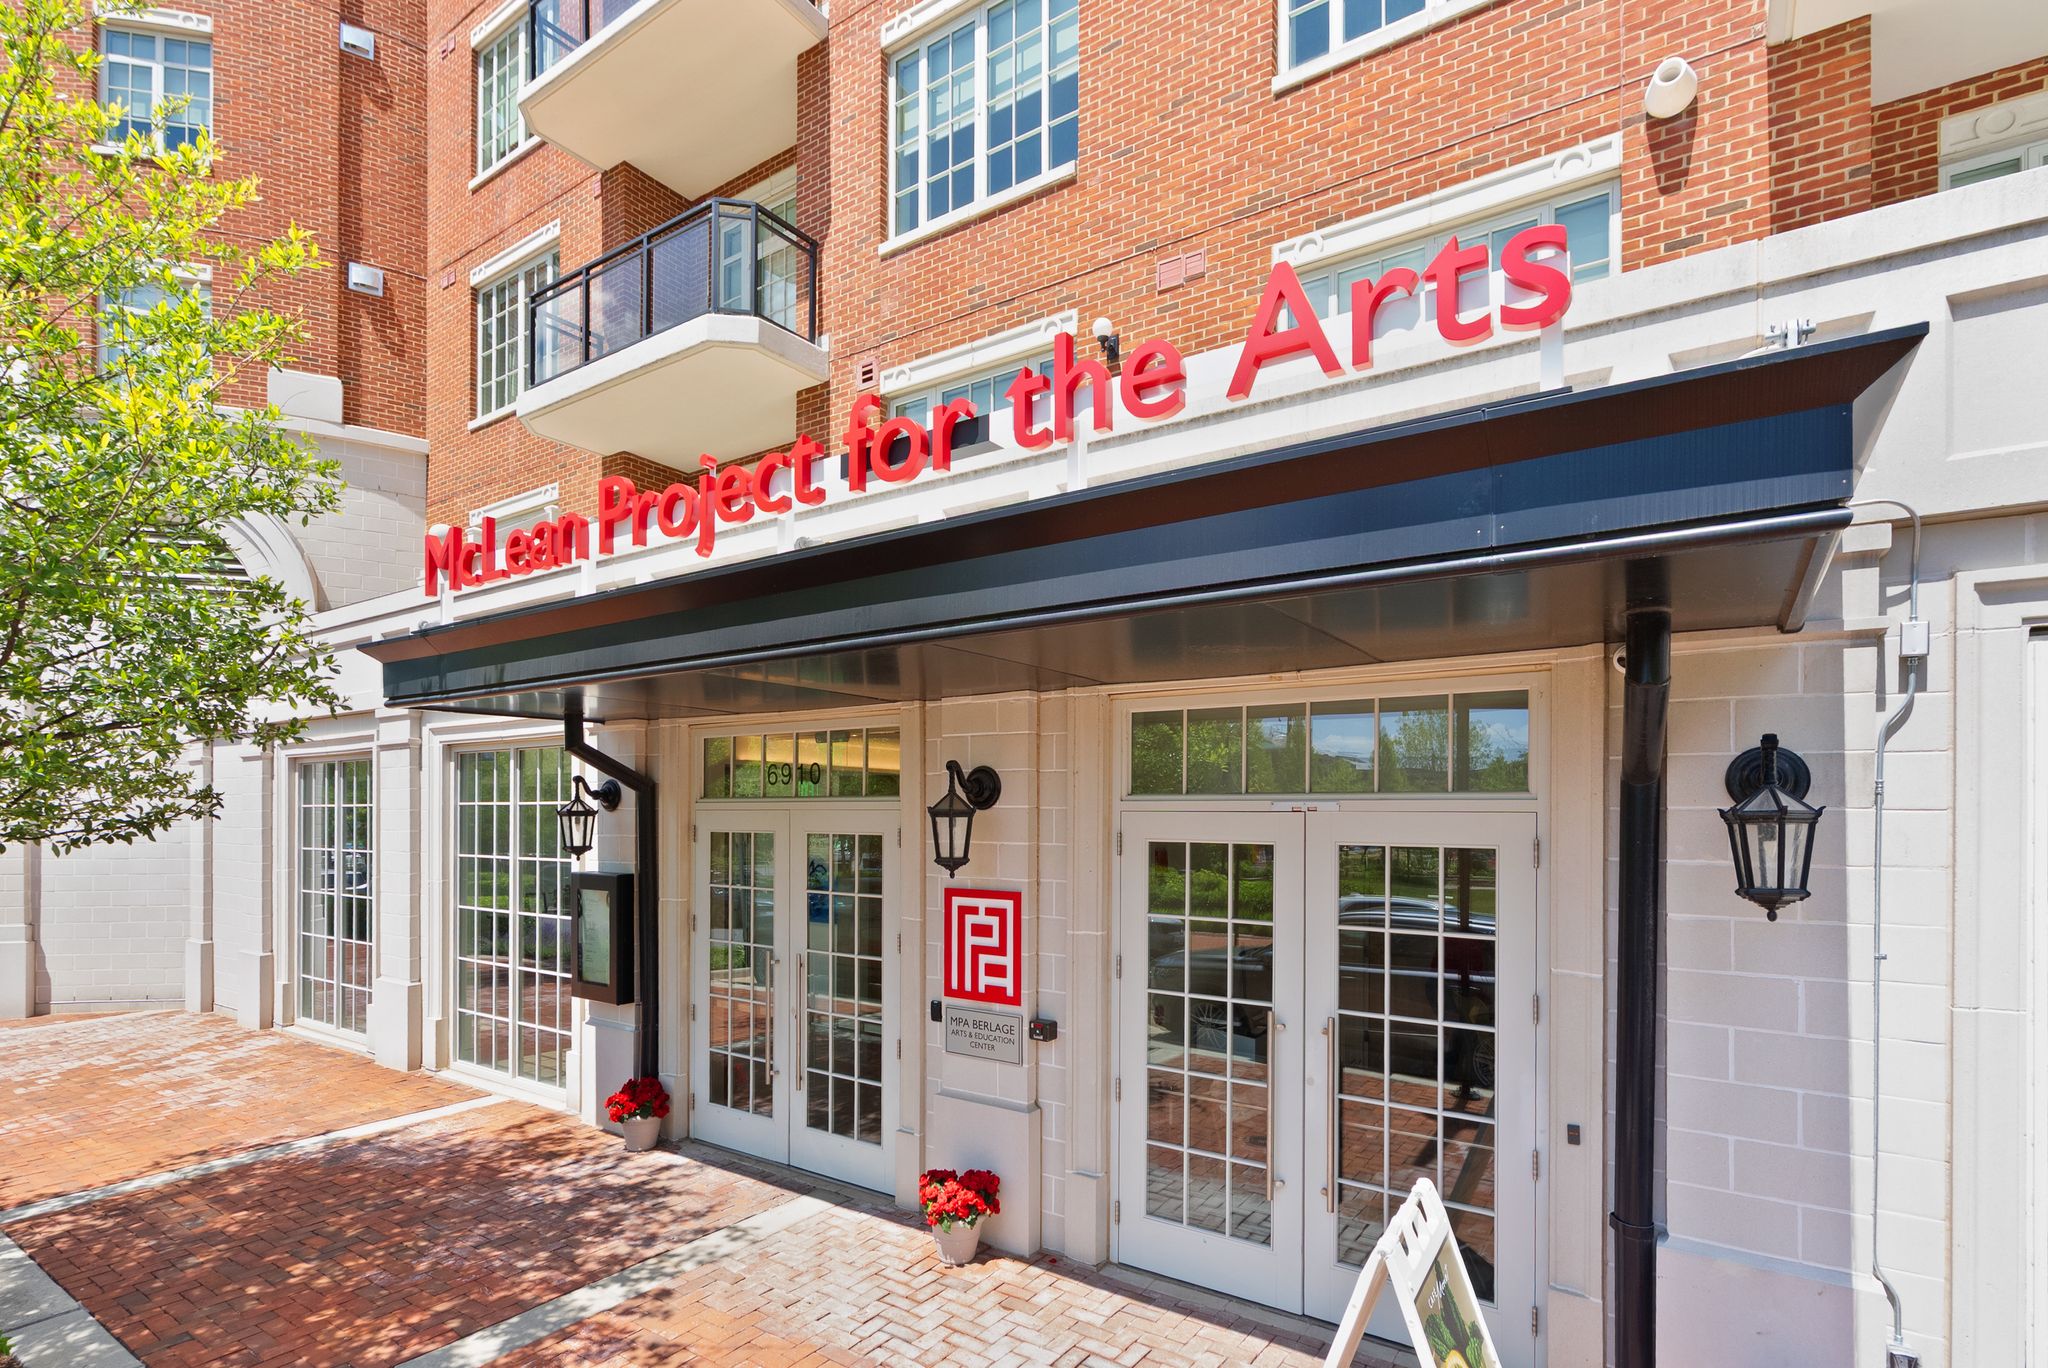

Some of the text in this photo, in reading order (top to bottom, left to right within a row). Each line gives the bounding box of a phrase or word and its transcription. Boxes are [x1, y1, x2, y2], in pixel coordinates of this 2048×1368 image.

[425, 223, 1573, 596] McLean Project for the Arts
[767, 762, 821, 786] 6910
[950, 1016, 1015, 1035] MPA BERLAGE
[951, 1029, 968, 1038] ARTS
[974, 1033, 1015, 1046] EDUCATION
[969, 1041, 996, 1052] CENTER
